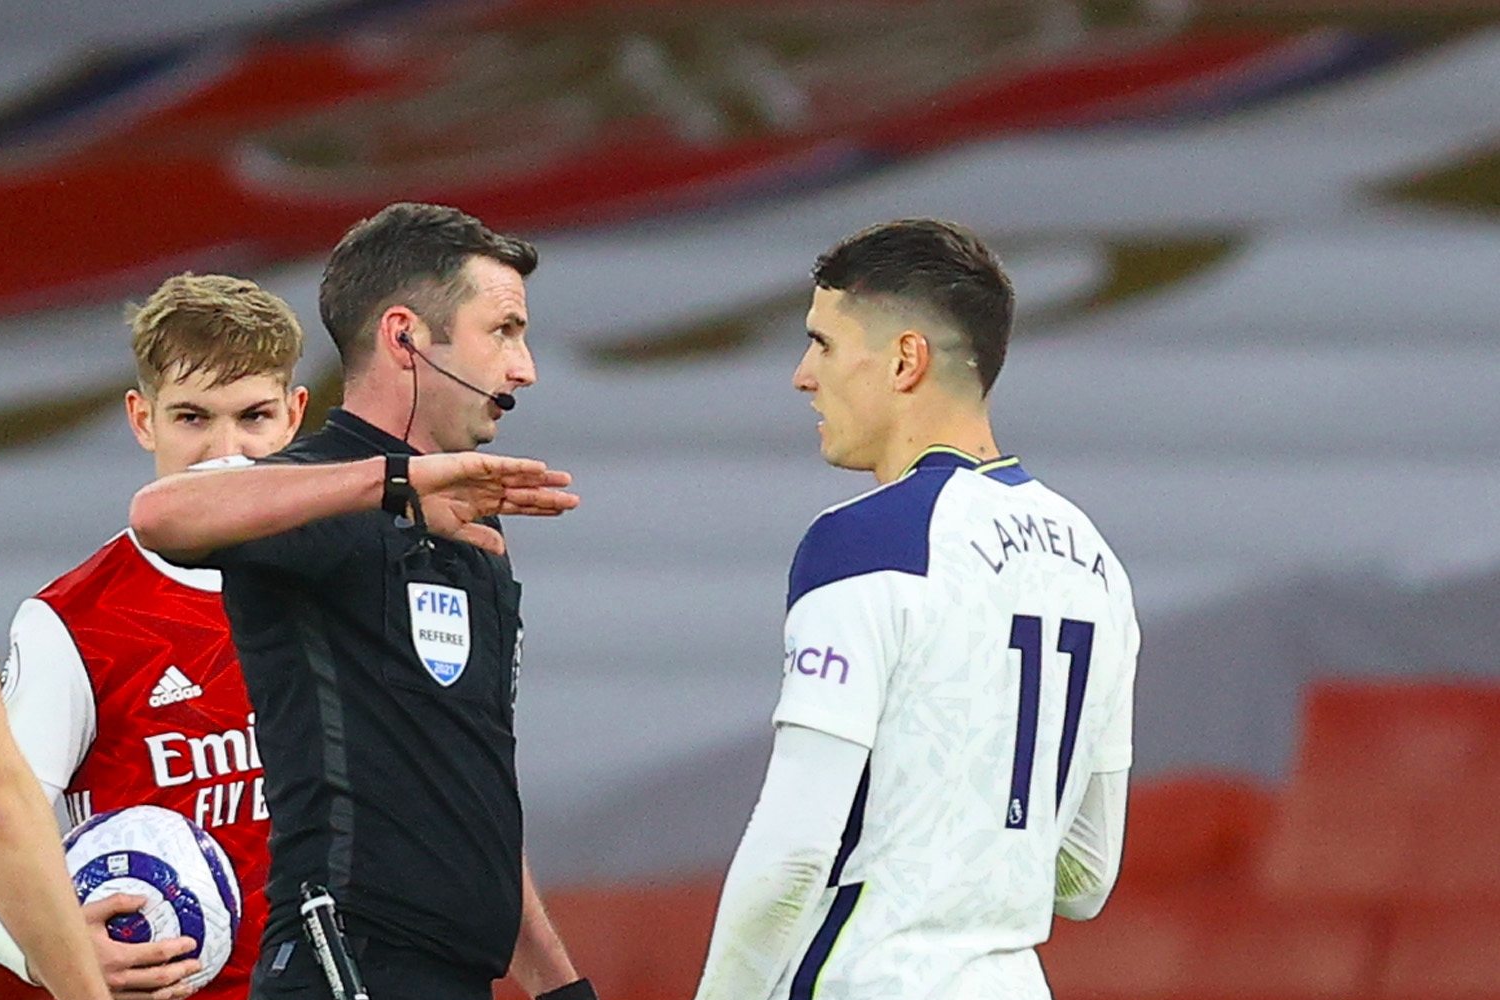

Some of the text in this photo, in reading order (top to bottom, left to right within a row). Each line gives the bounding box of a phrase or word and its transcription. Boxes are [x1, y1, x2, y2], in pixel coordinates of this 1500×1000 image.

[970, 513, 1109, 594] LAMELA
[416, 590, 463, 618] FIFA
[419, 629, 465, 647] REFEREE
[433, 662, 456, 676] 2021
[148, 683, 203, 708] adidas
[1004, 613, 1096, 830] 11
[194, 780, 246, 829] FLY
